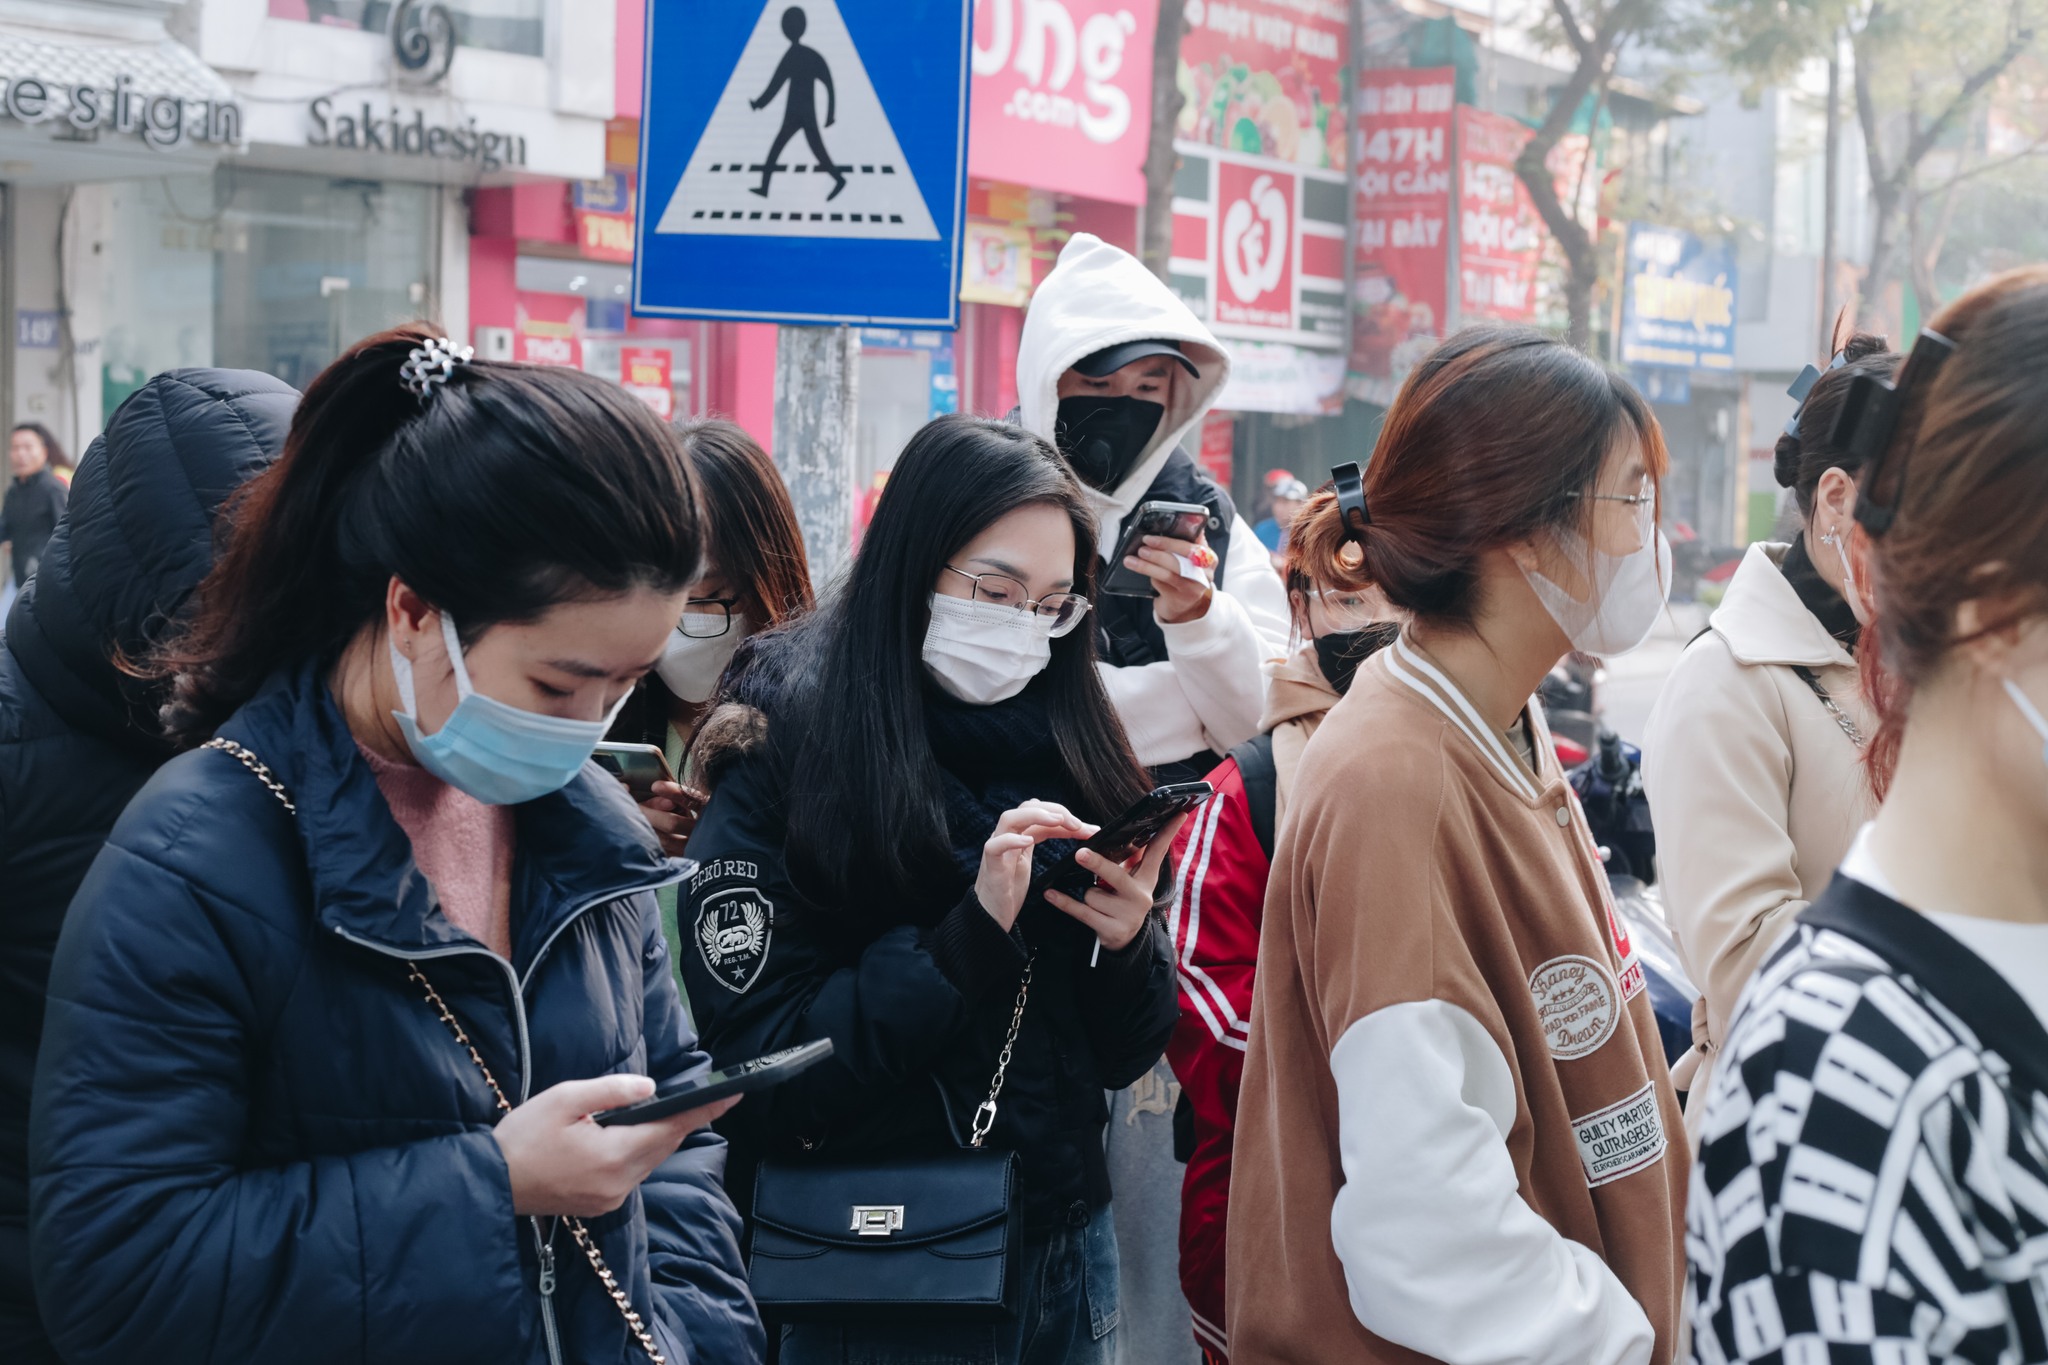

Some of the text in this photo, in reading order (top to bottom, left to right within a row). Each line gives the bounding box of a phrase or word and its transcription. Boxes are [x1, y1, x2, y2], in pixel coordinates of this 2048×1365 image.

[1003, 87, 1076, 128] .com
[307, 96, 526, 173] Sakidesign
[724, 860, 758, 880] RED
[719, 900, 740, 922] 72
[1563, 1012, 1579, 1024] FOR
[1577, 995, 1607, 1018] FAME
[1579, 1097, 1654, 1144] GUILTY PARTIES
[1592, 1116, 1657, 1158] OUTRAGEOUS
